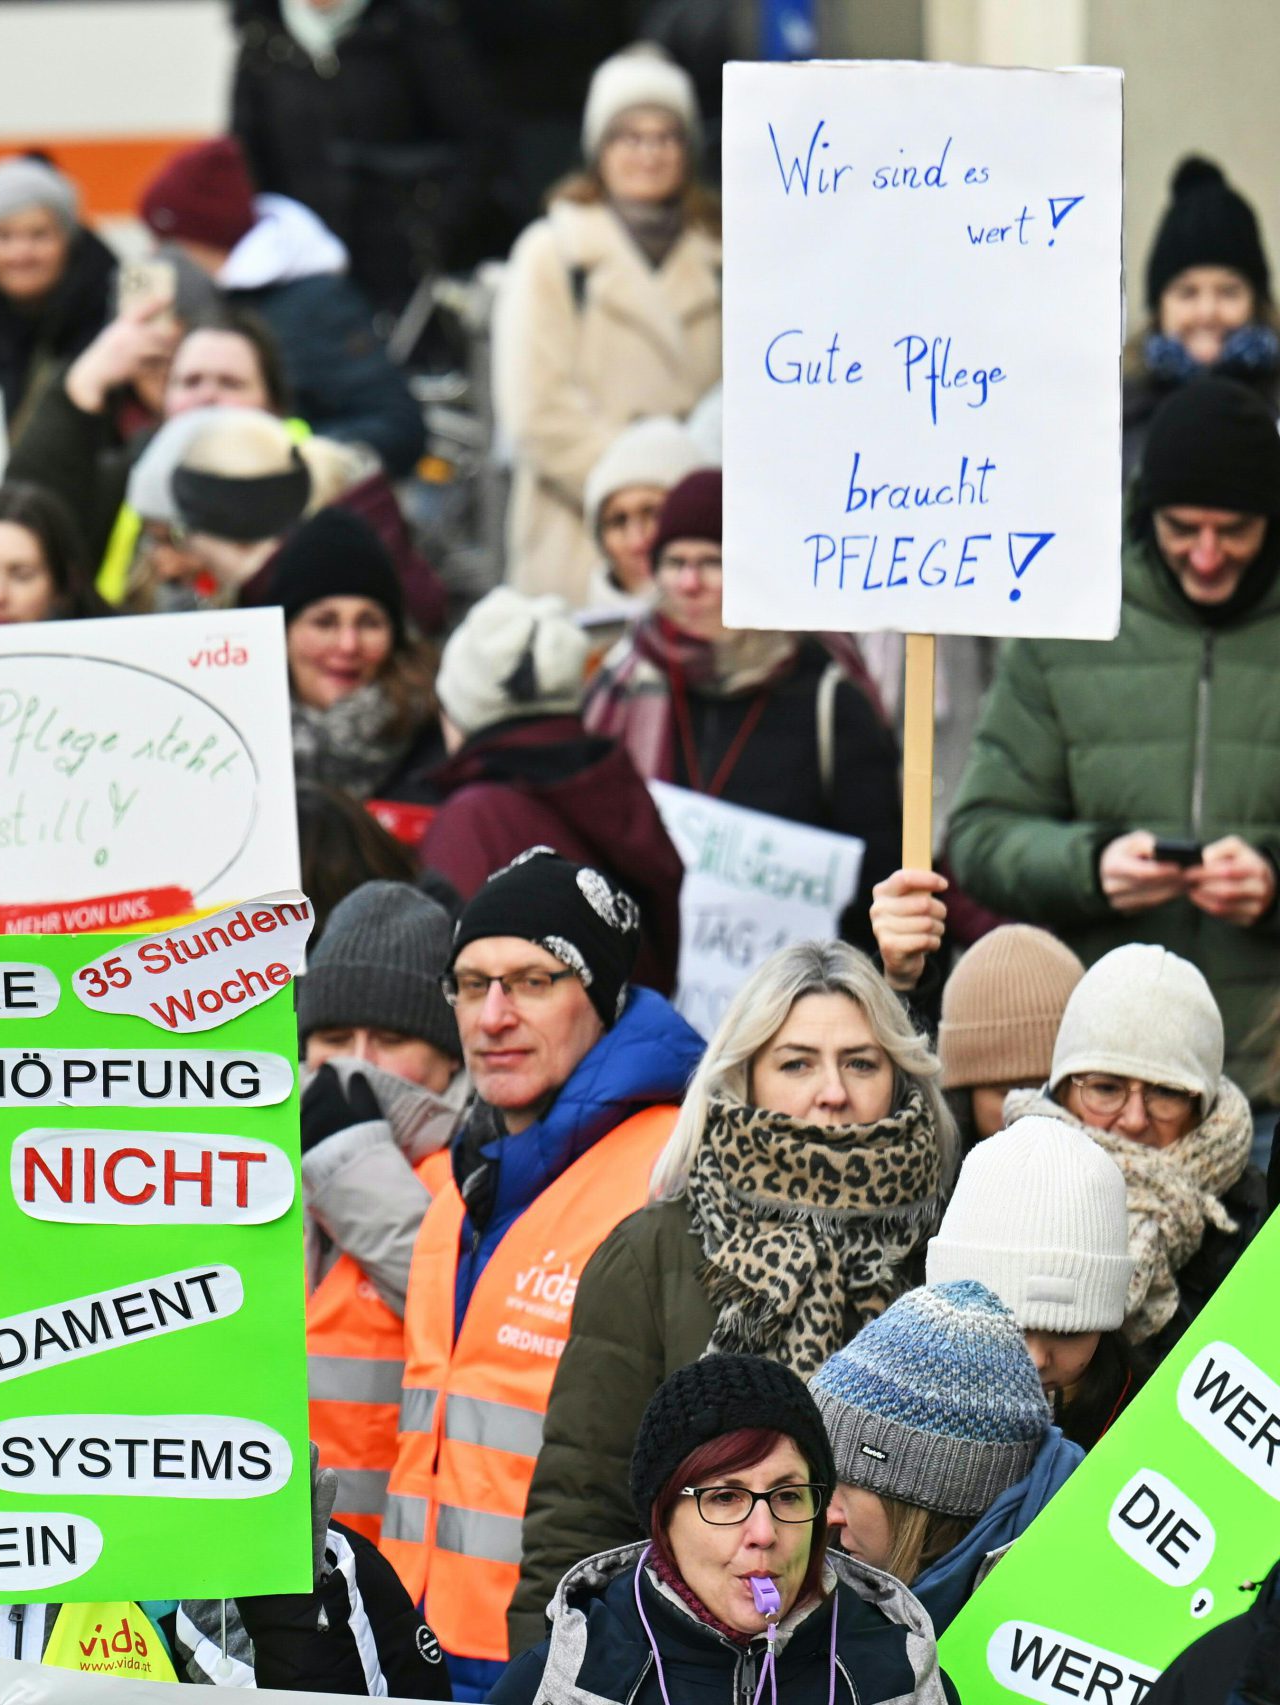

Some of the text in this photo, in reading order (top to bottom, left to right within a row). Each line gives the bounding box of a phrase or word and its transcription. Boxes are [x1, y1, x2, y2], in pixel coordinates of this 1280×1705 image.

[769, 121, 989, 196] Wir sind es
[765, 330, 1007, 425] Gute Pflege
[845, 453, 996, 513] braucht
[187, 638, 249, 668] vida
[134, 716, 238, 779] steht
[5, 909, 62, 934] MEHR
[64, 904, 106, 928] VON
[79, 957, 133, 998] 35
[150, 962, 292, 1028] Woche
[23, 1147, 267, 1208] NICHT
[515, 1250, 579, 1306] vida
[0, 1437, 272, 1481] SYSTEMS
[1118, 1484, 1201, 1569] DIE
[79, 1618, 148, 1658] vida
[80, 1657, 152, 1673] www.vida.at
